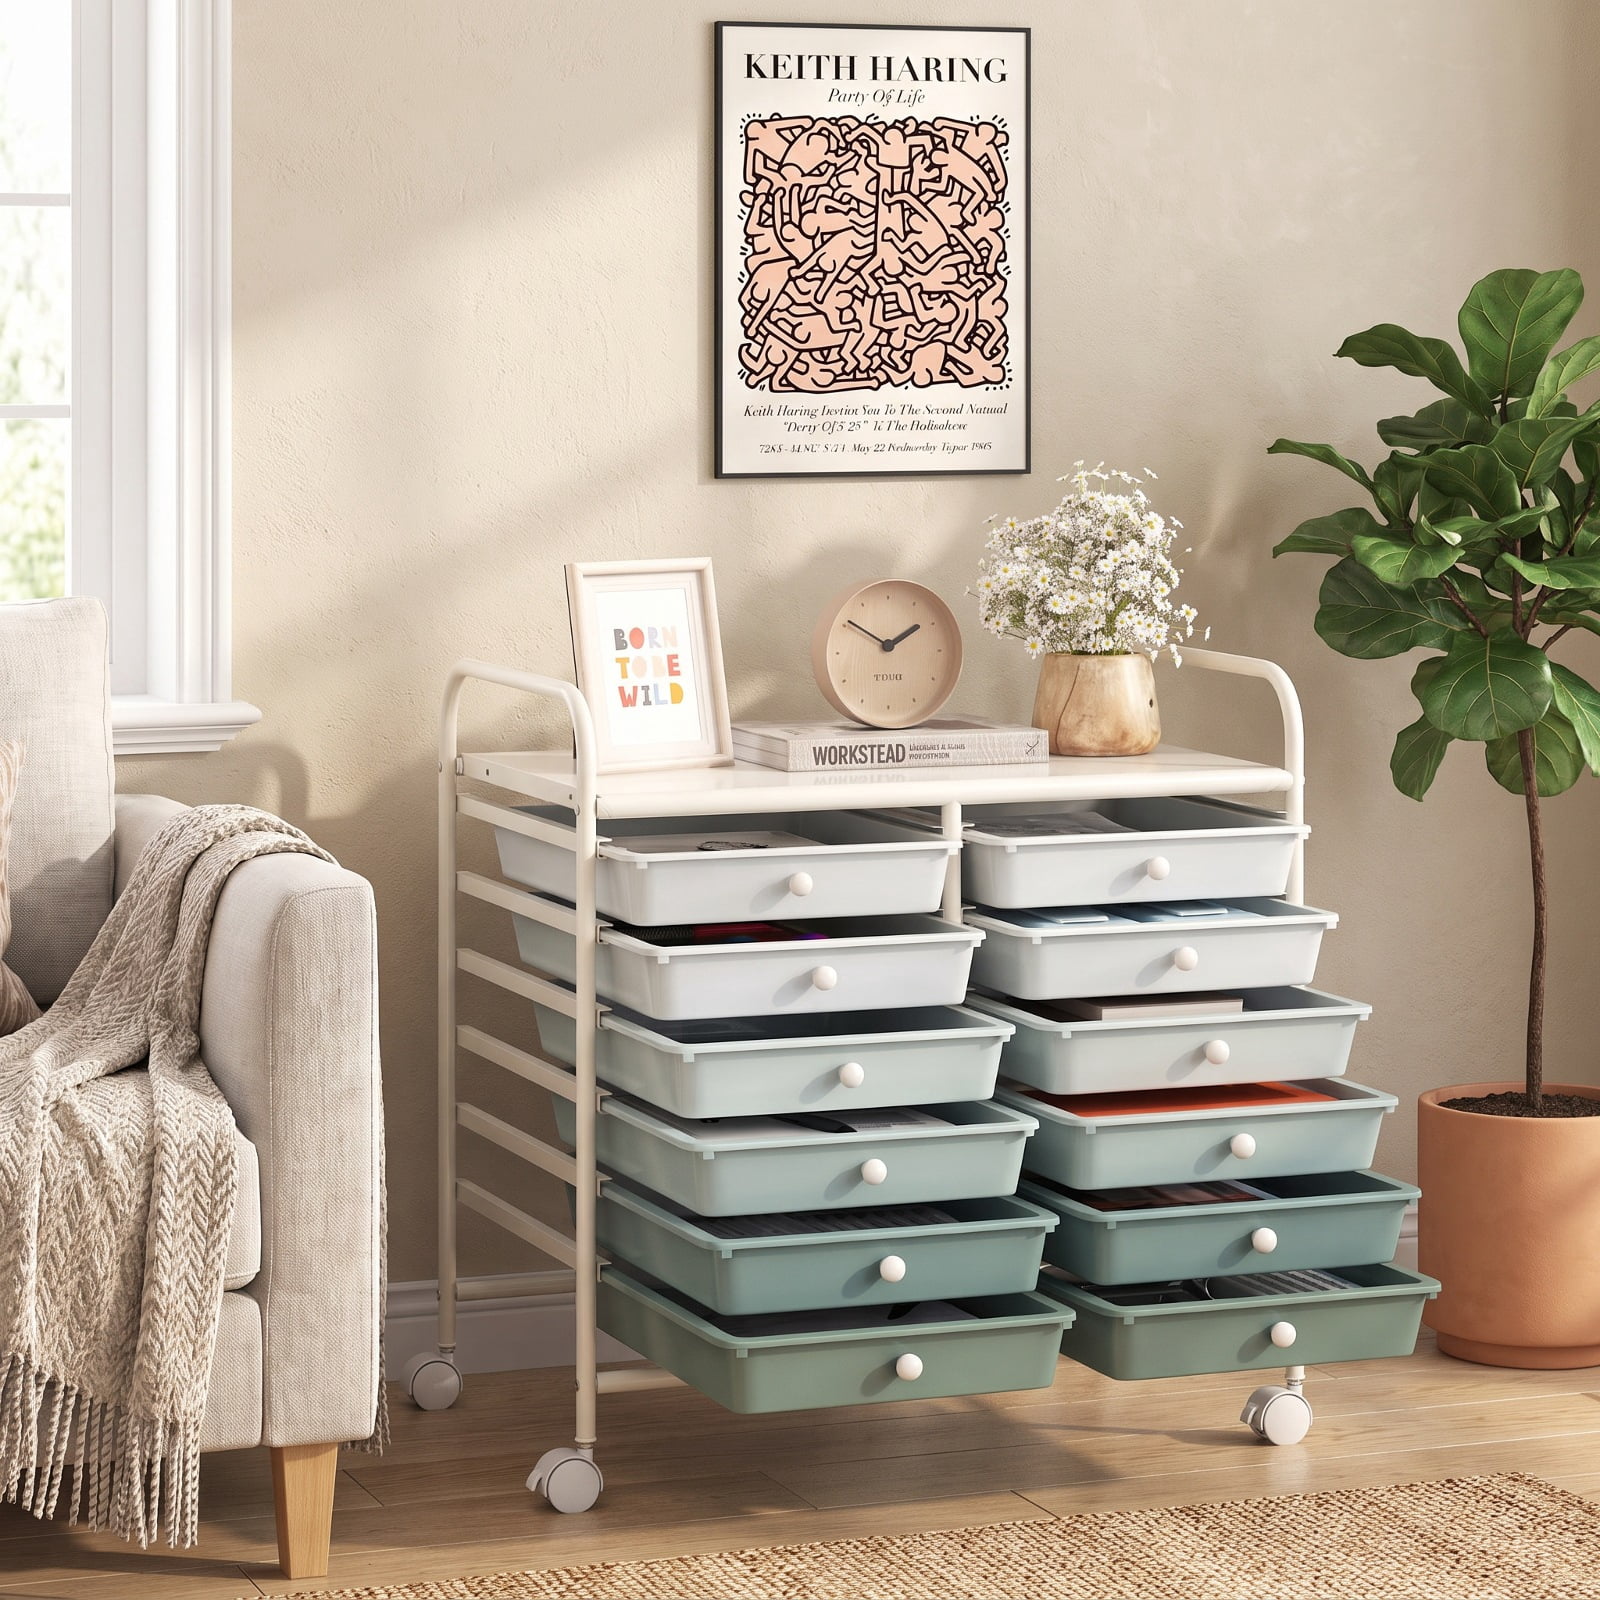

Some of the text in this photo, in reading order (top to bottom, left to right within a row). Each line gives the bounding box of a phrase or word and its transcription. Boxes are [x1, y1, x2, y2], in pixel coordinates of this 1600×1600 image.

[744, 53, 1008, 84] KEITH HARING
[828, 88, 870, 107] Party
[895, 89, 926, 108] Life
[613, 626, 678, 651] BORN
[617, 682, 684, 708] WILD
[812, 743, 905, 766] WORKSTEAD
